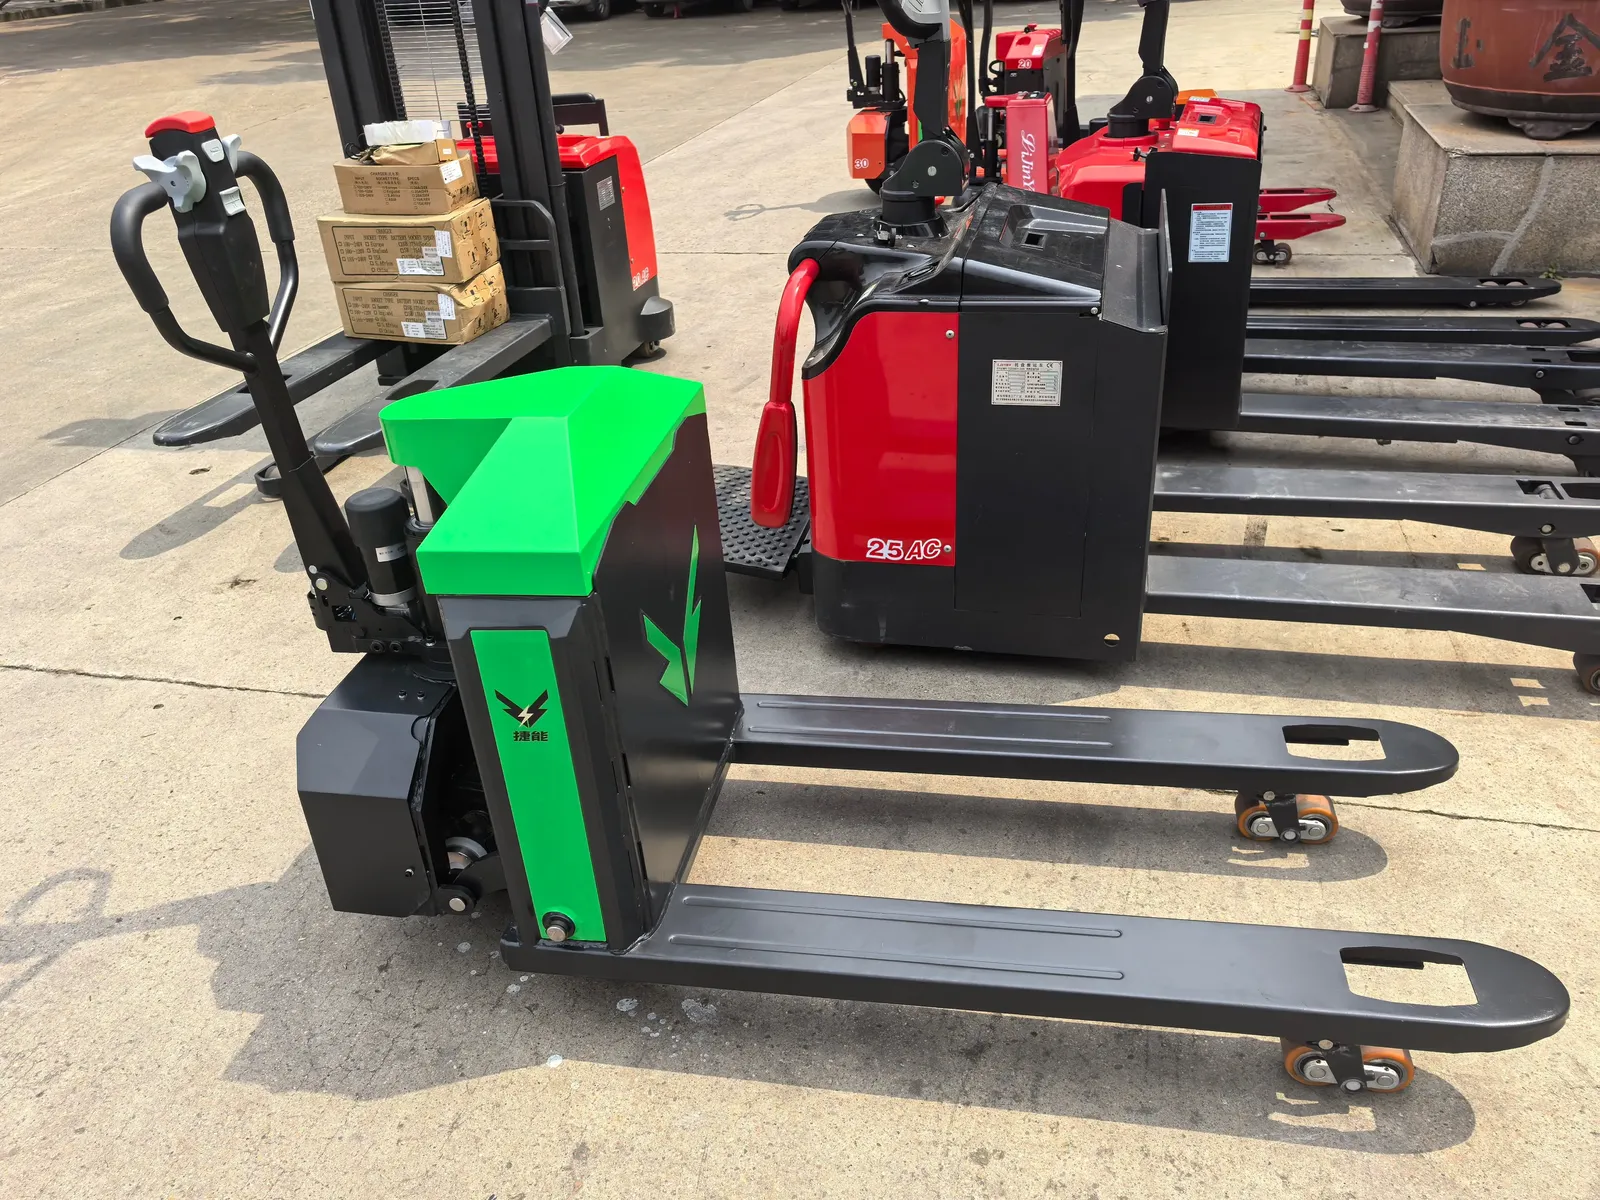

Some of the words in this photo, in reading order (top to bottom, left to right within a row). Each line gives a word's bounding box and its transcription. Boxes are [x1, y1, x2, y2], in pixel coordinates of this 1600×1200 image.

[1017, 58, 1032, 69] 20
[854, 158, 870, 169] 30
[1020, 130, 1036, 192] LiJinY
[513, 730, 549, 742] 捷能
